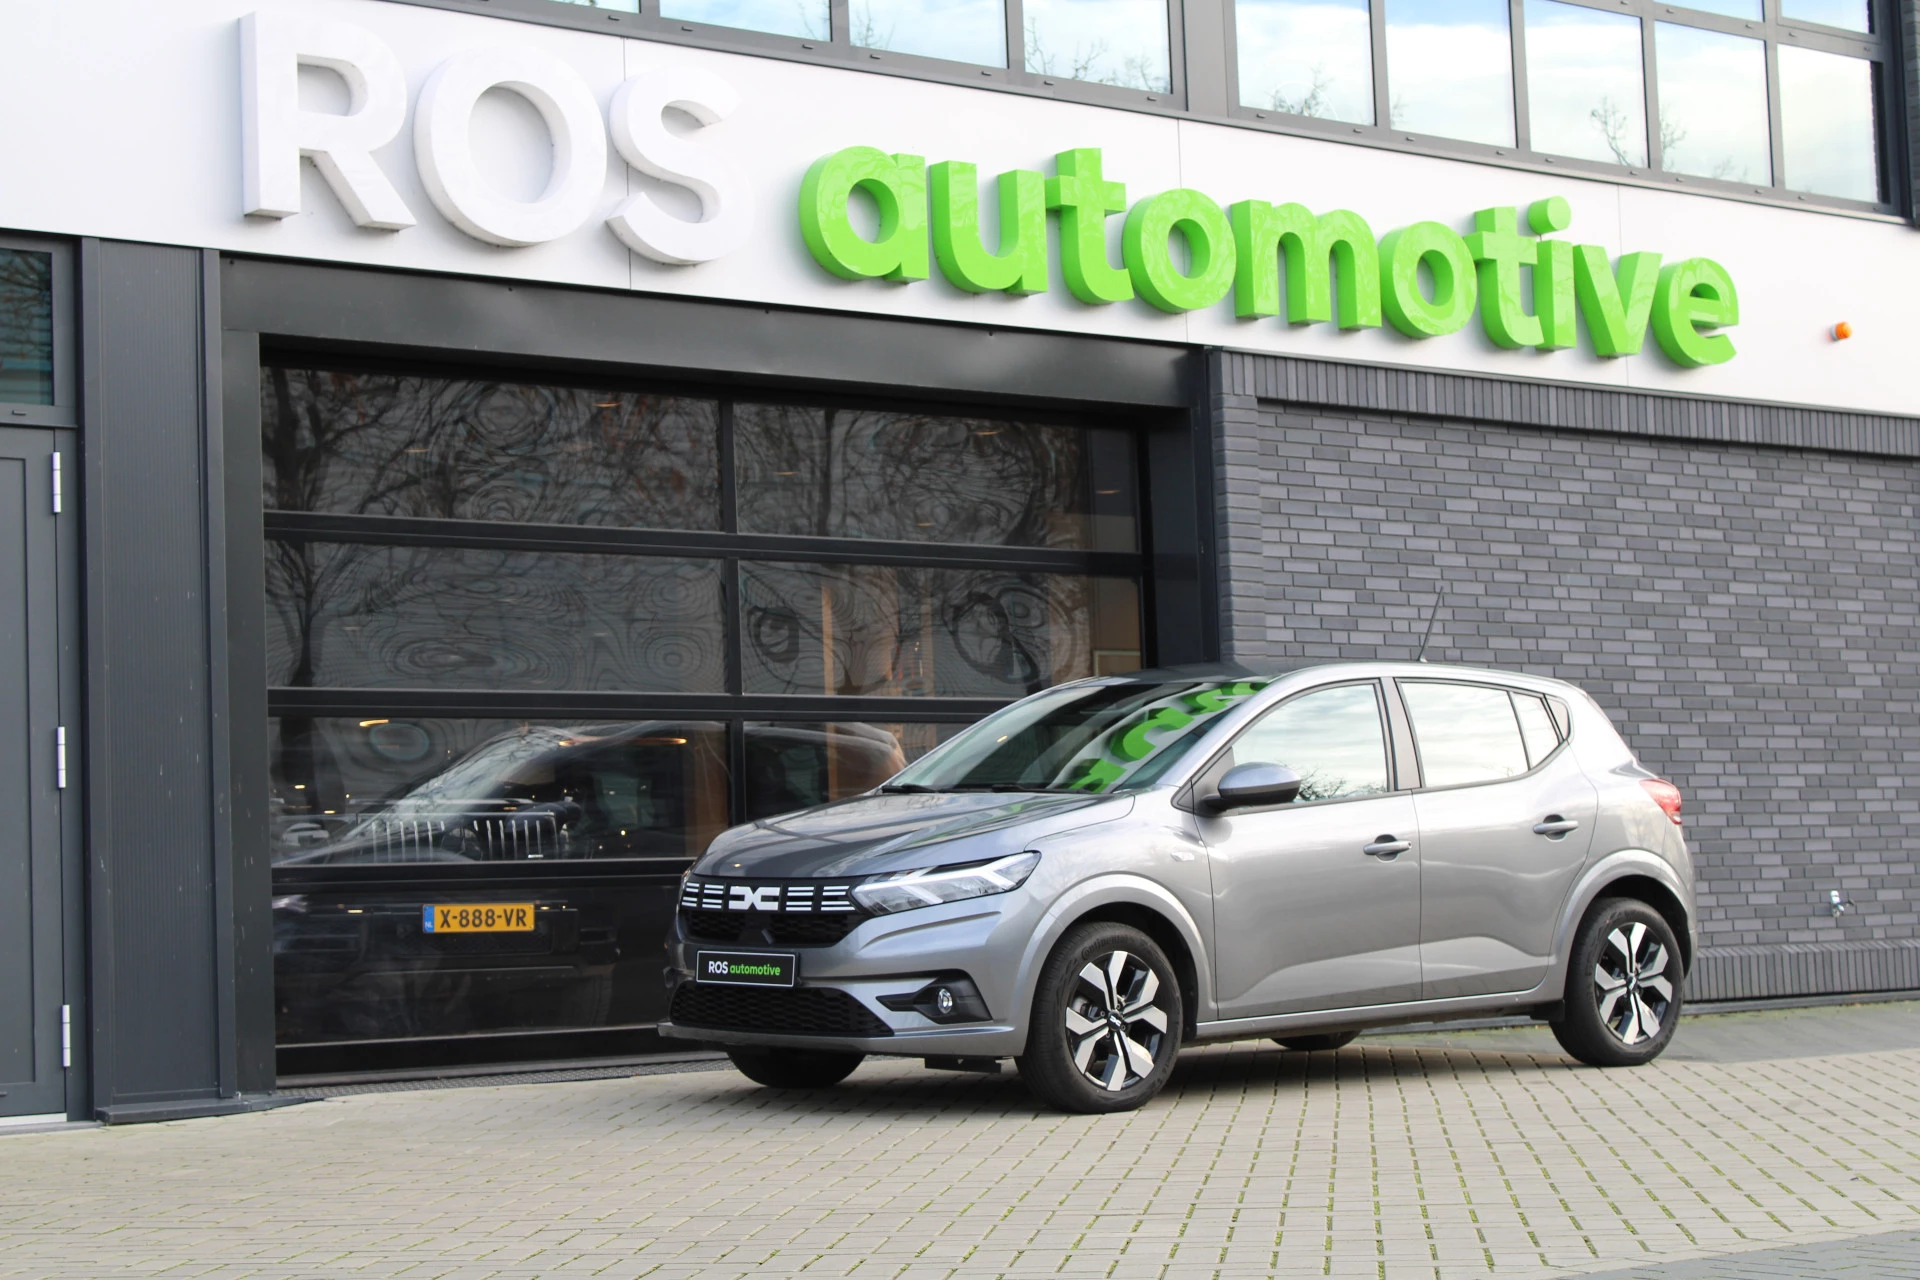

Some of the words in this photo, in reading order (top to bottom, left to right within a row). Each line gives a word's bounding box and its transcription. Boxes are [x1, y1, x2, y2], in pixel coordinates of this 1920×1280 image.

[239, 10, 755, 265] ROS
[799, 147, 1739, 369] automotive
[440, 908, 527, 928] X-888-VR
[708, 961, 729, 974] ROS
[730, 963, 781, 976] automotive
